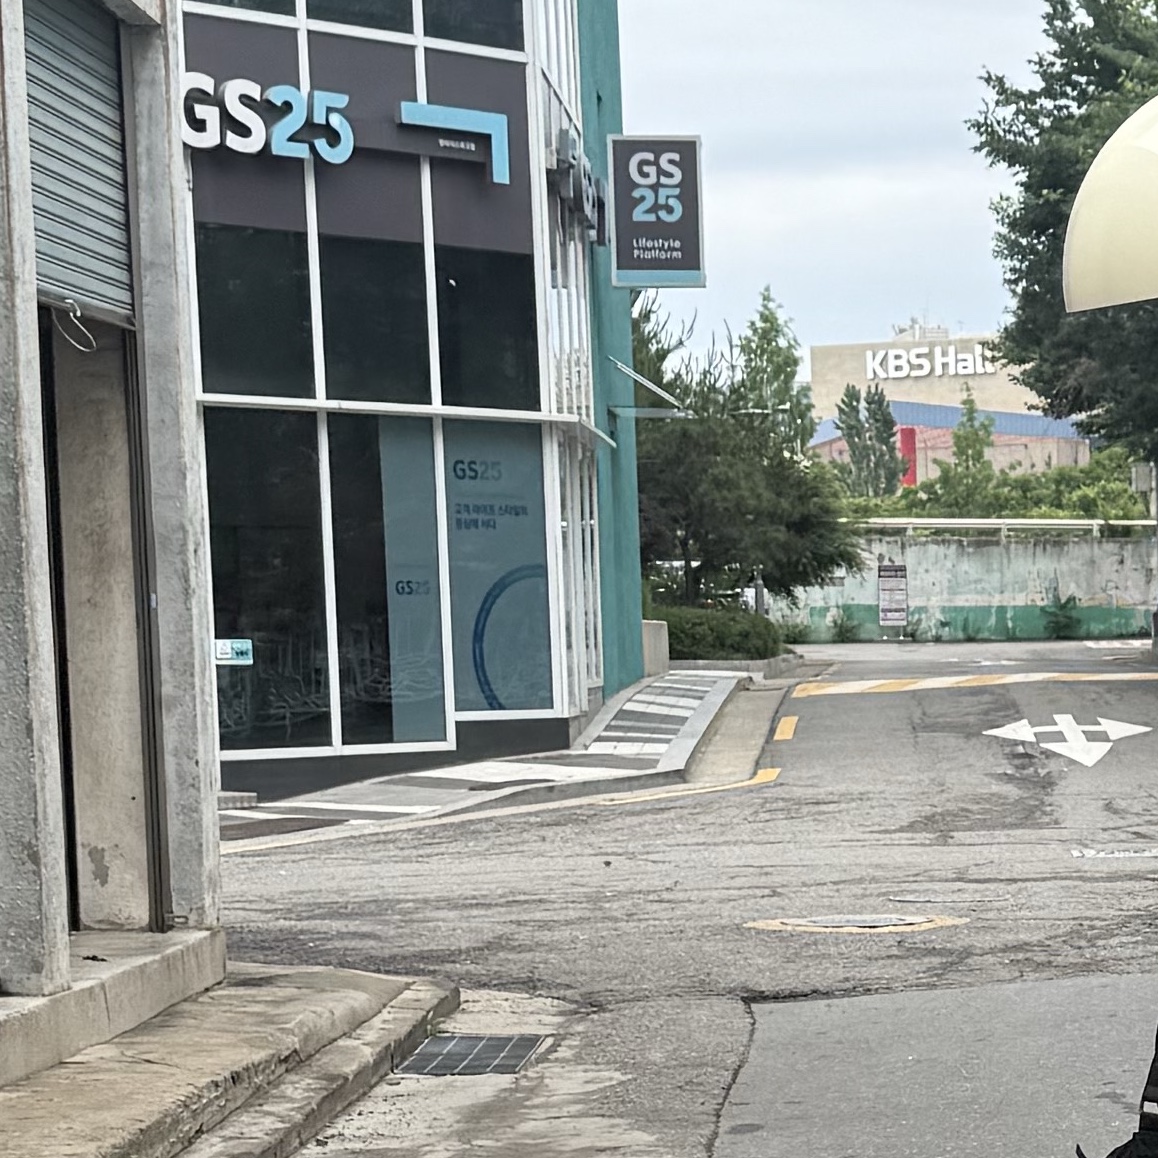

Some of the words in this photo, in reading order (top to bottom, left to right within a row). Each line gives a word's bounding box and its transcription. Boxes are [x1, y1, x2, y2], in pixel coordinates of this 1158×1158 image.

[181, 72, 354, 165] GS25
[628, 151, 683, 186] GS
[631, 187, 683, 223] 25
[632, 237, 682, 250] Lifestyle
[632, 249, 682, 260] Platform
[865, 346, 932, 380] KBS
[453, 459, 502, 481] GS25
